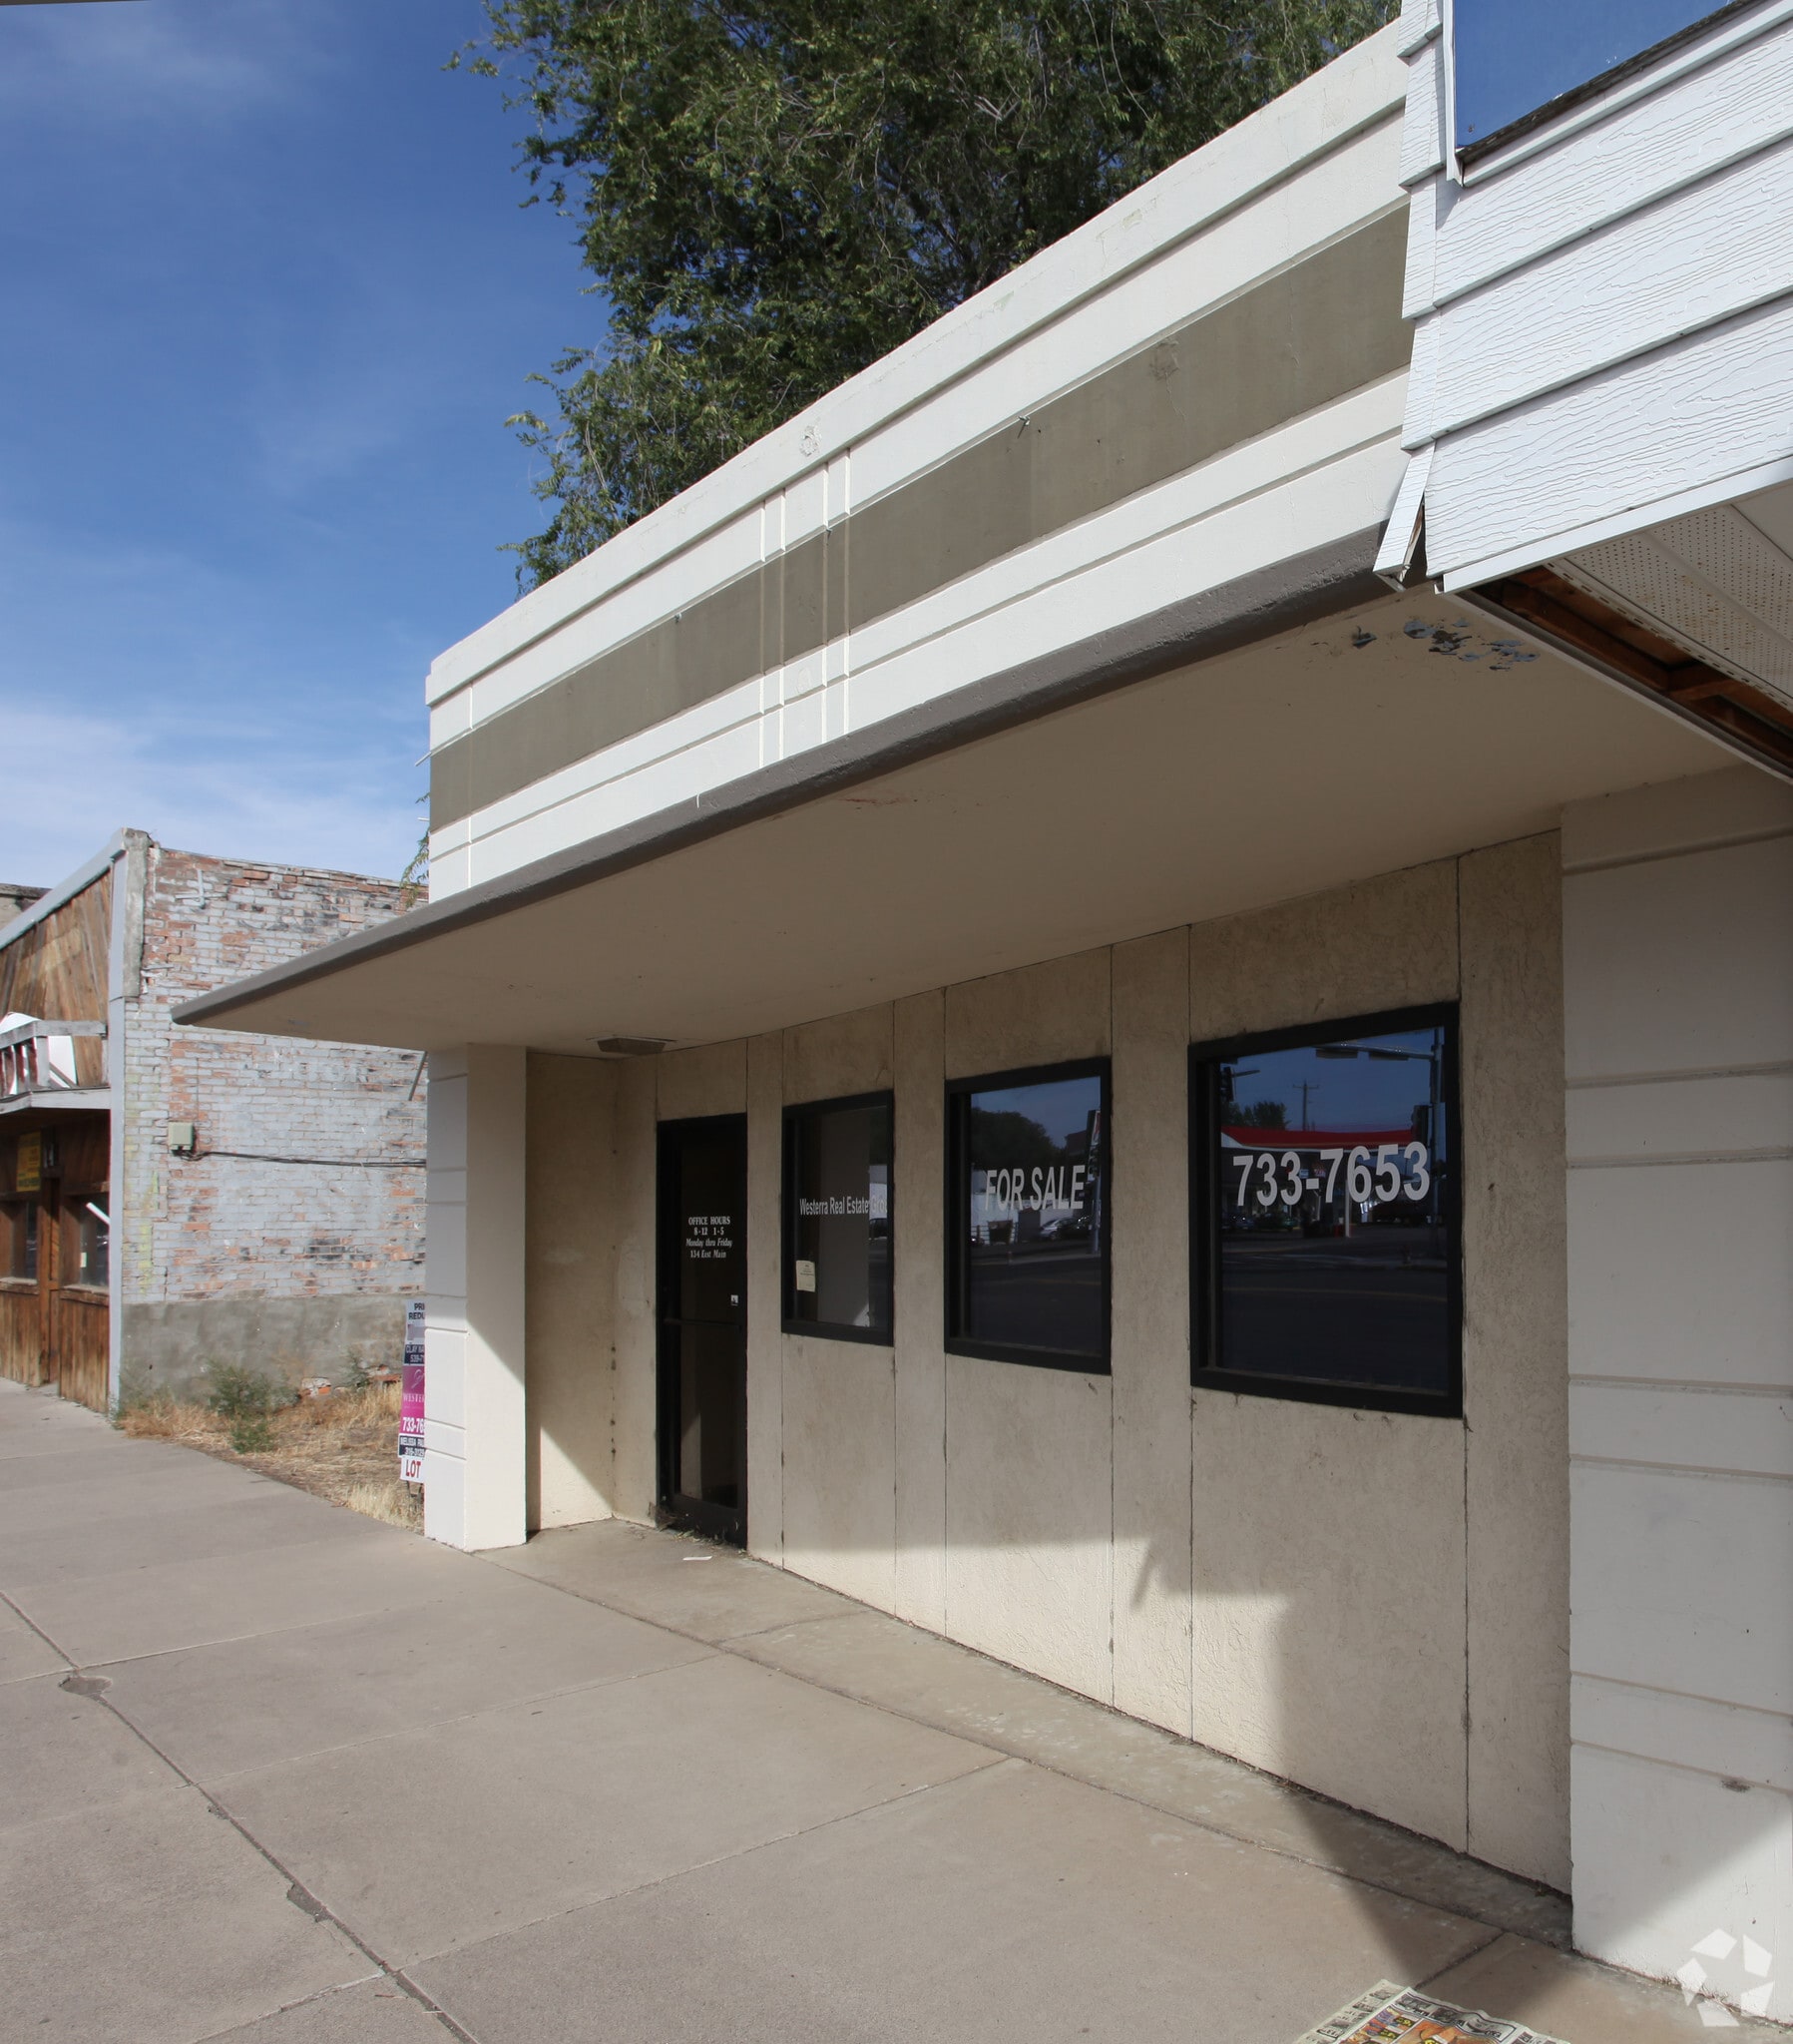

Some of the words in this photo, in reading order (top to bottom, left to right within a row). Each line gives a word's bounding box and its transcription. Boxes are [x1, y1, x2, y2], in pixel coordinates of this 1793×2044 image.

[1233, 1141, 1430, 1206] 733-7653
[985, 1169, 1025, 1211] FOR
[1030, 1165, 1086, 1211] SALE
[799, 1199, 828, 1215] Westerra
[829, 1197, 845, 1215] Real
[846, 1196, 869, 1215] Estate
[688, 1217, 708, 1226] OFFICE
[710, 1216, 730, 1226] HOURS
[686, 1239, 704, 1248] Monday
[717, 1238, 732, 1248] Friday
[406, 1459, 421, 1478] LOT
